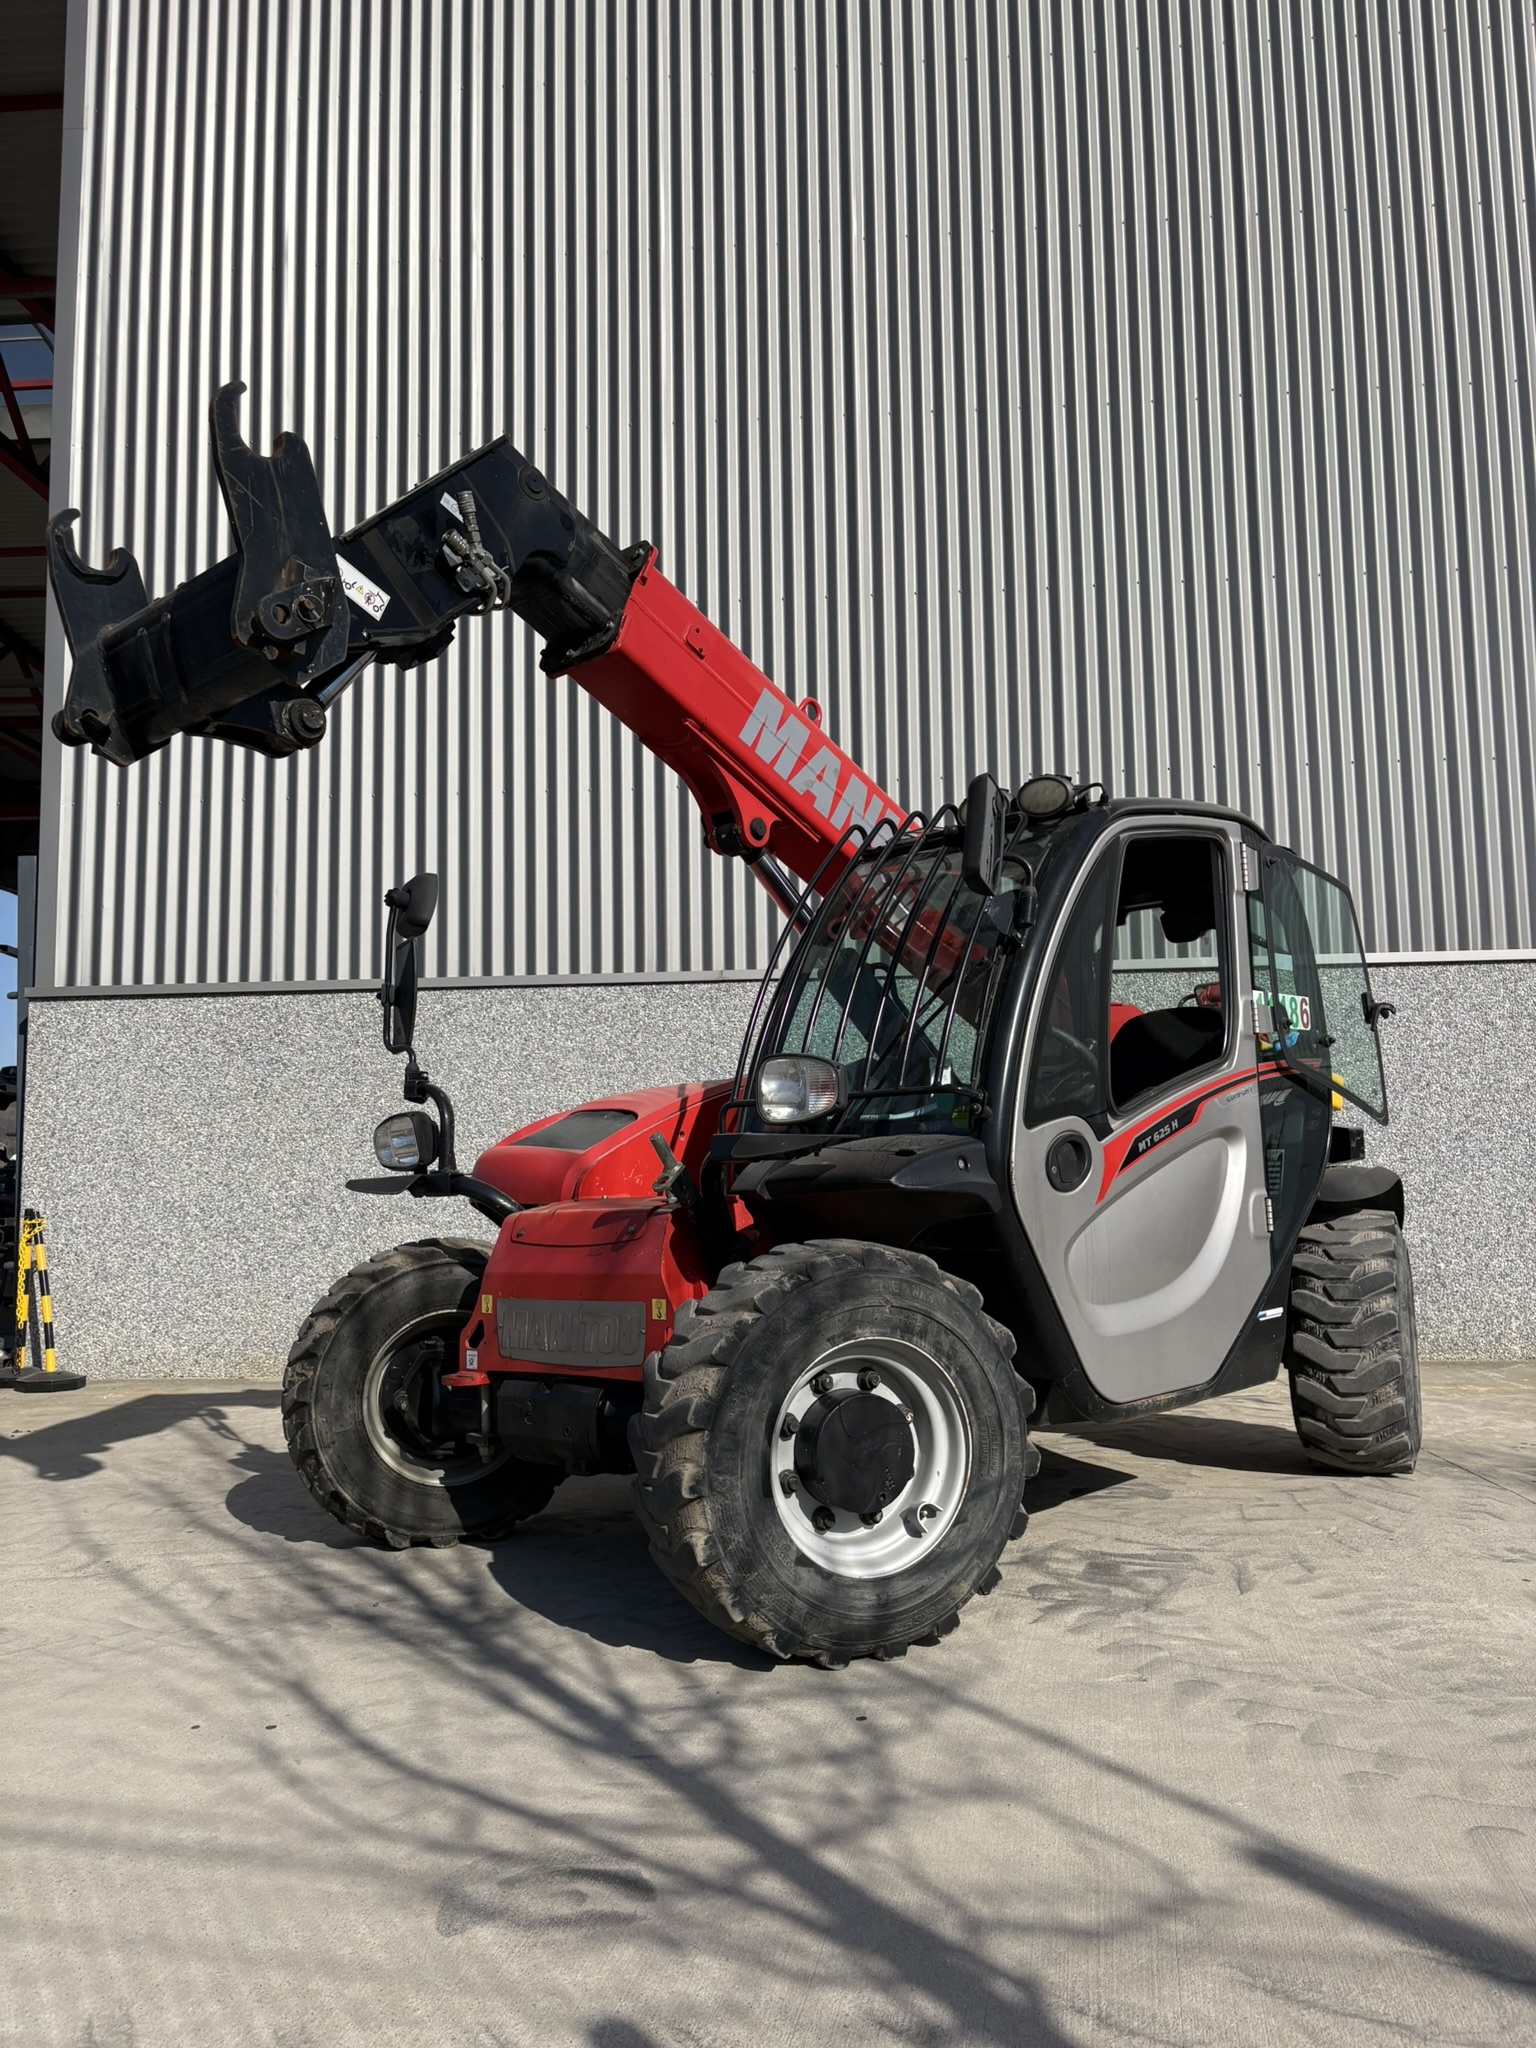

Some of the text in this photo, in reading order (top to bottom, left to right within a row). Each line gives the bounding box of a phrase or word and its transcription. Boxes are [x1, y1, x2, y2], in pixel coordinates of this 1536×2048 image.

[1138, 1118, 1179, 1153] MT 625 H
[501, 1311, 641, 1355] MANITOU
